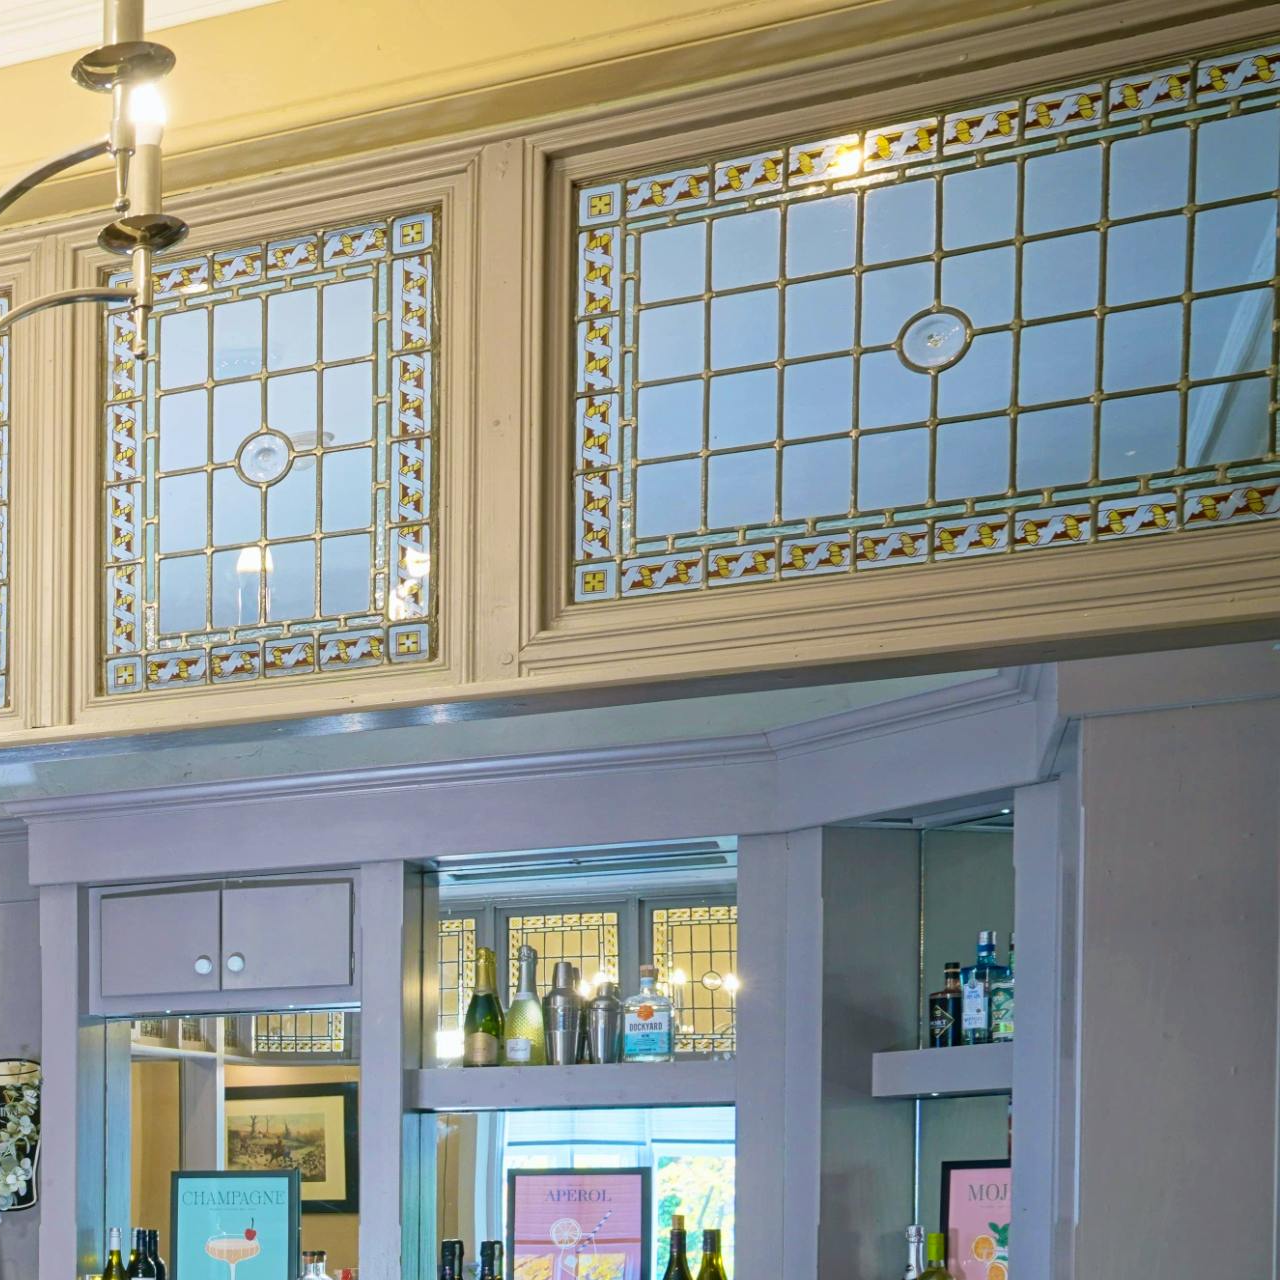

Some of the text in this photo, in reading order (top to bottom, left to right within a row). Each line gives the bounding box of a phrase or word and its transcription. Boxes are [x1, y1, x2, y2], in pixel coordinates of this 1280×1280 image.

[629, 1022, 663, 1032] DOCKYARD
[182, 1190, 286, 1206] CHAMPAGNE
[545, 1189, 612, 1202] APEROL
[968, 1183, 1008, 1201] MOJ
